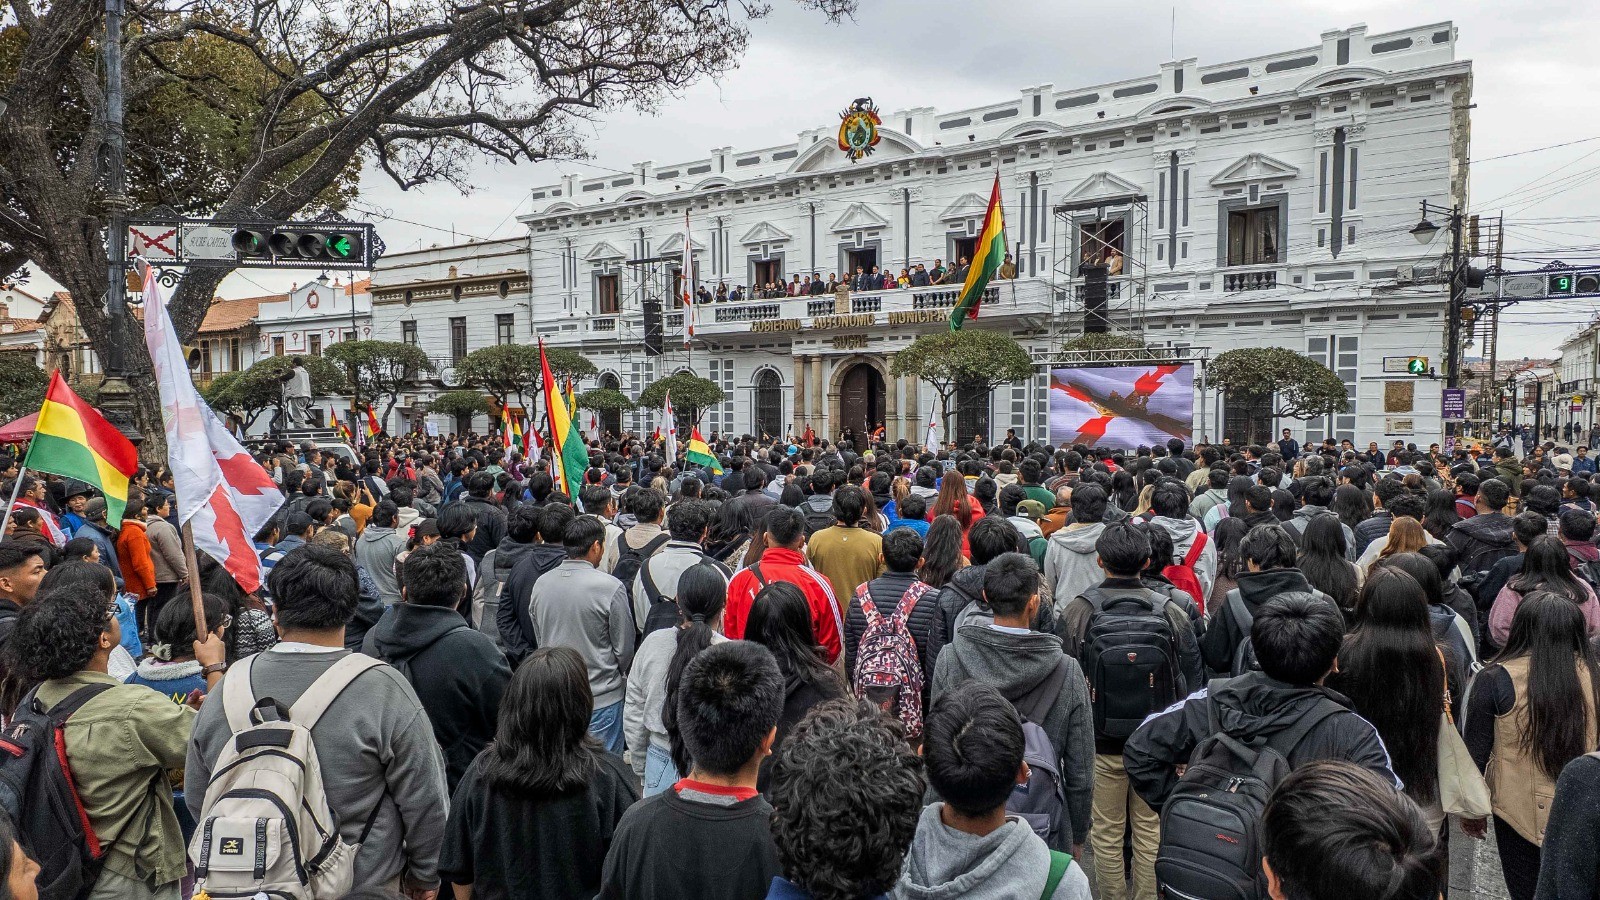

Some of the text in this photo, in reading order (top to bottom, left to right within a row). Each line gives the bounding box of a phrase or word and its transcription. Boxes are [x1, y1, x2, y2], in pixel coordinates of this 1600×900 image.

[1560, 278, 1568, 290] 9
[751, 318, 802, 332] GOBIERNO
[812, 313, 876, 329] AUTONOMO
[832, 333, 869, 350] SUCRE
